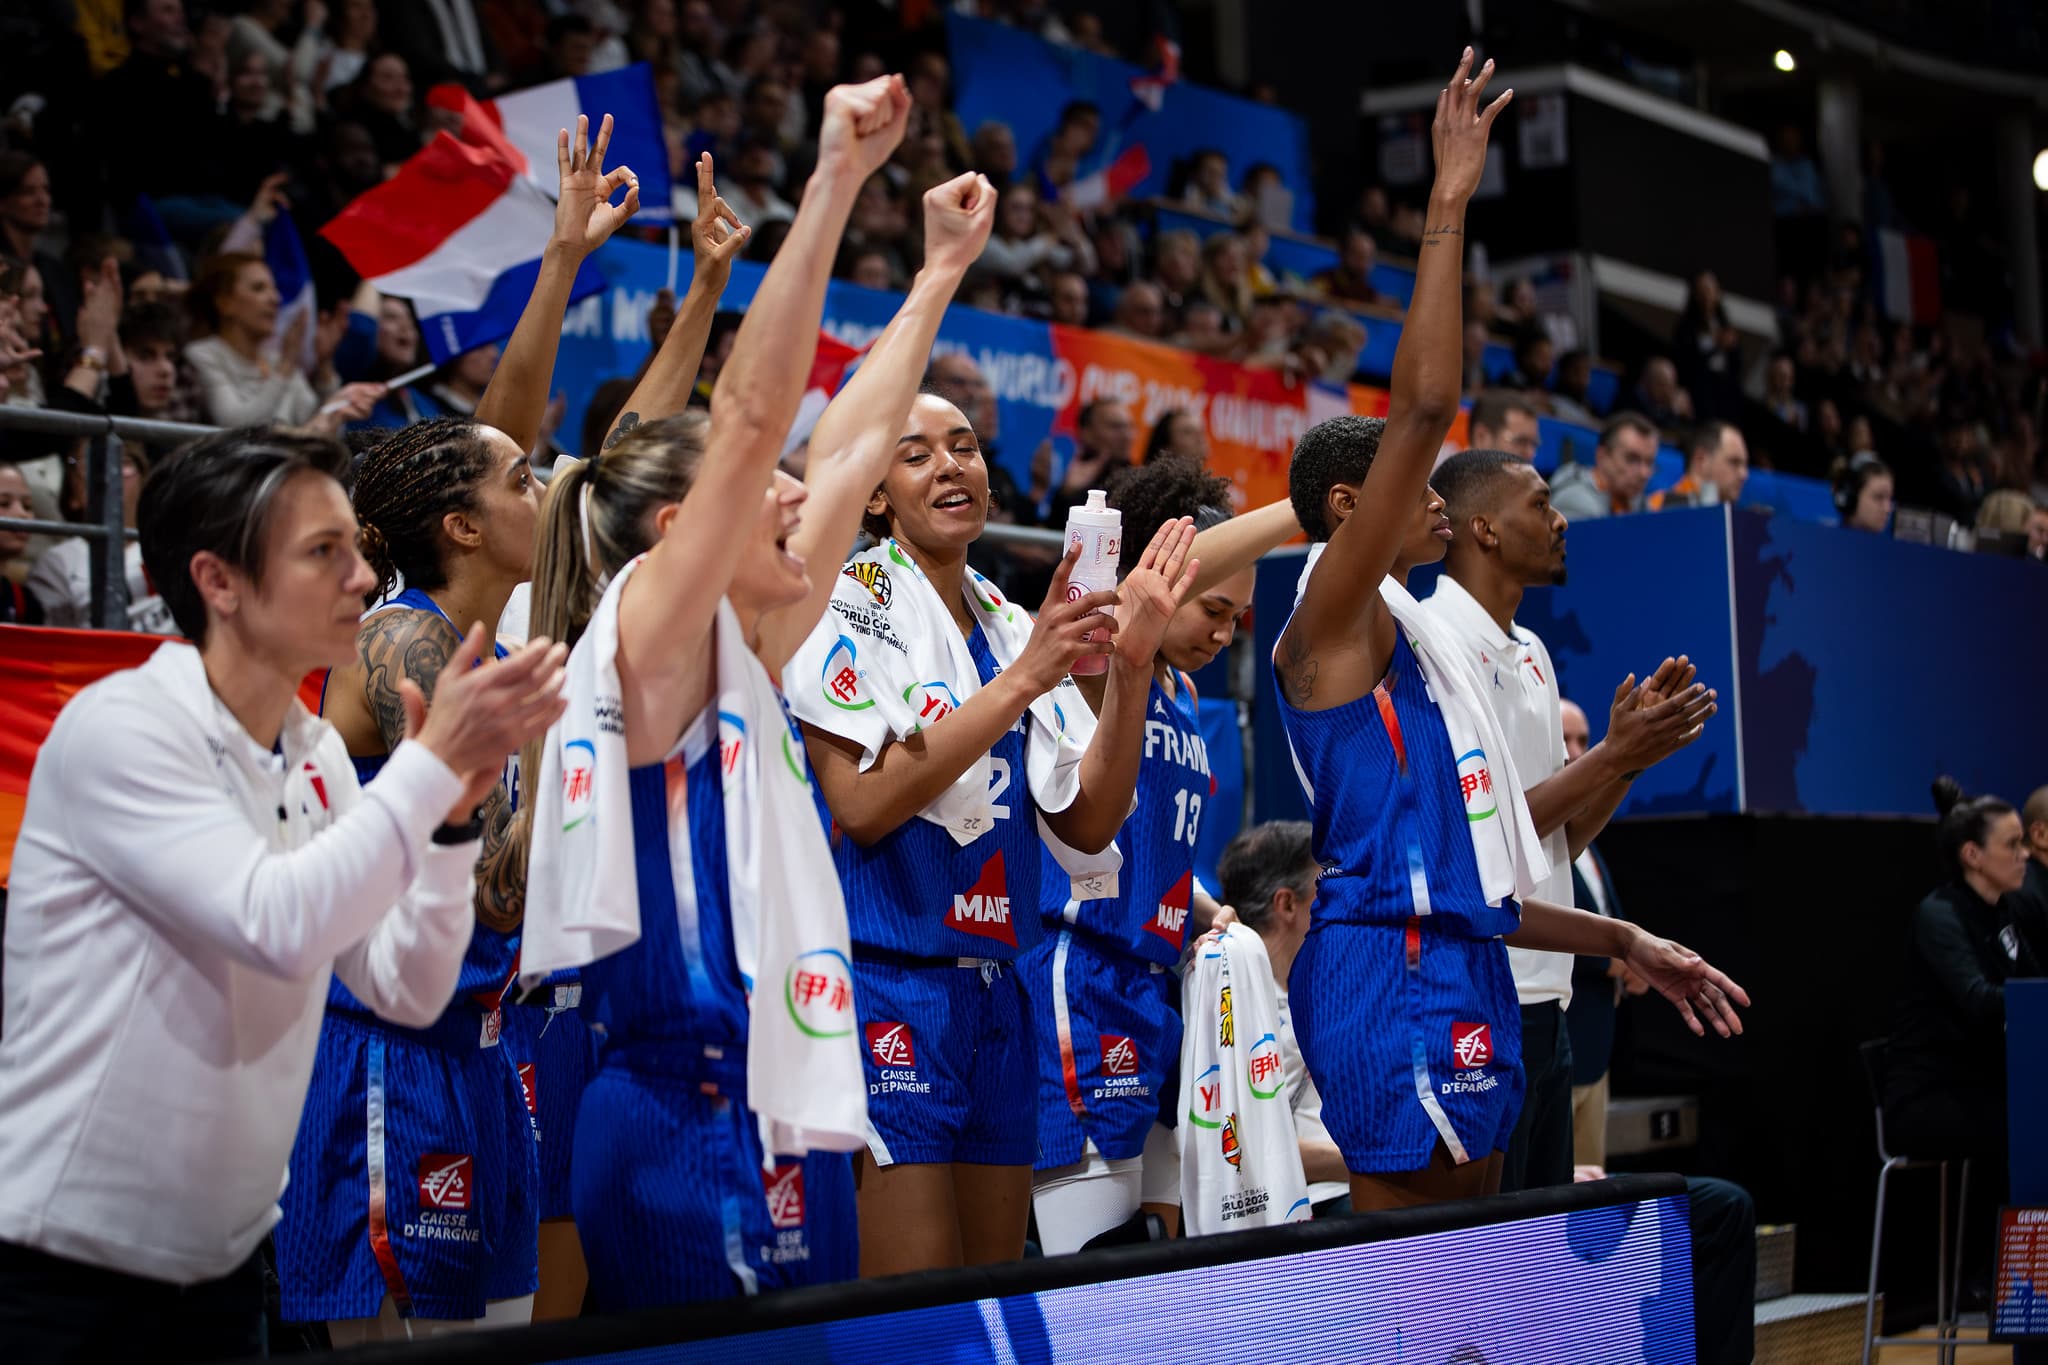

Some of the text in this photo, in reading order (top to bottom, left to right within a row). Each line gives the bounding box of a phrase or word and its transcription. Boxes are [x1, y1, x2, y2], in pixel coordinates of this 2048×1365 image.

[919, 692, 954, 723] Yi
[1173, 788, 1202, 847] 13
[1085, 876, 1102, 893] 22
[953, 894, 1010, 924] MAIF
[1157, 902, 1190, 932] MAIF
[880, 1069, 918, 1081] CAISSE
[1104, 1076, 1141, 1087] CAISSE
[869, 1081, 932, 1095] D'EPARGNE
[1094, 1086, 1151, 1099] D'EPARGNE
[1441, 1076, 1499, 1095] D'EPARGNE
[1245, 1192, 1269, 1207] 2026
[419, 1211, 468, 1227] CAISSE
[403, 1223, 480, 1242] D'EPARGNE
